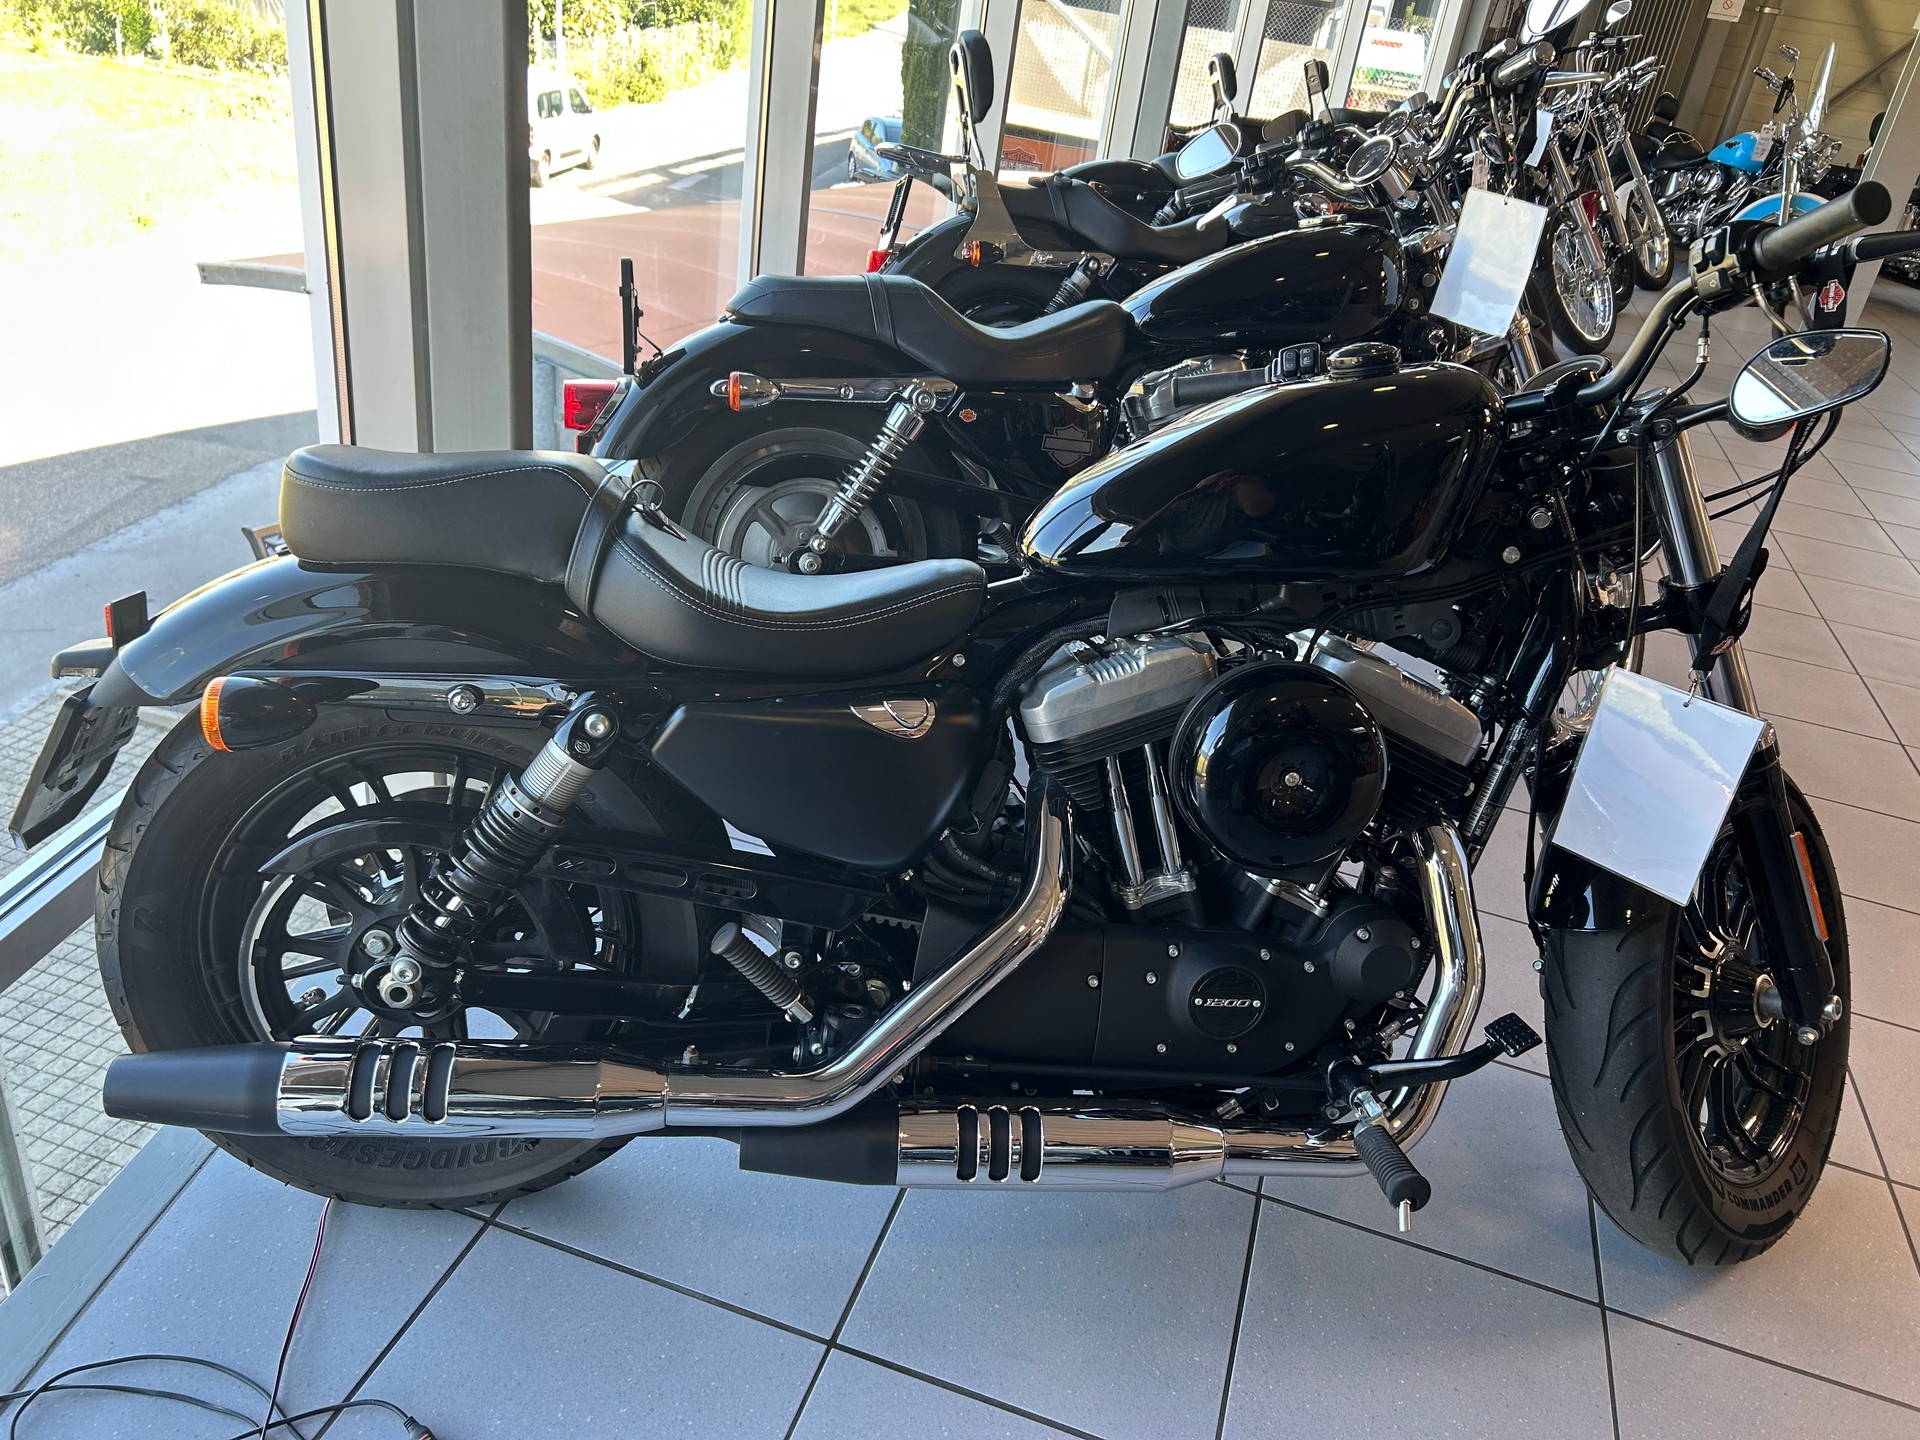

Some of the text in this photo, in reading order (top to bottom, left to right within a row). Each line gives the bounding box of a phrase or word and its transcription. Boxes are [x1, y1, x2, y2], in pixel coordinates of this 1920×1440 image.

[1204, 998, 1251, 1008] 1200
[306, 1137, 525, 1171] BRIDGESTO
[1727, 1180, 1793, 1212] COMMANDER
